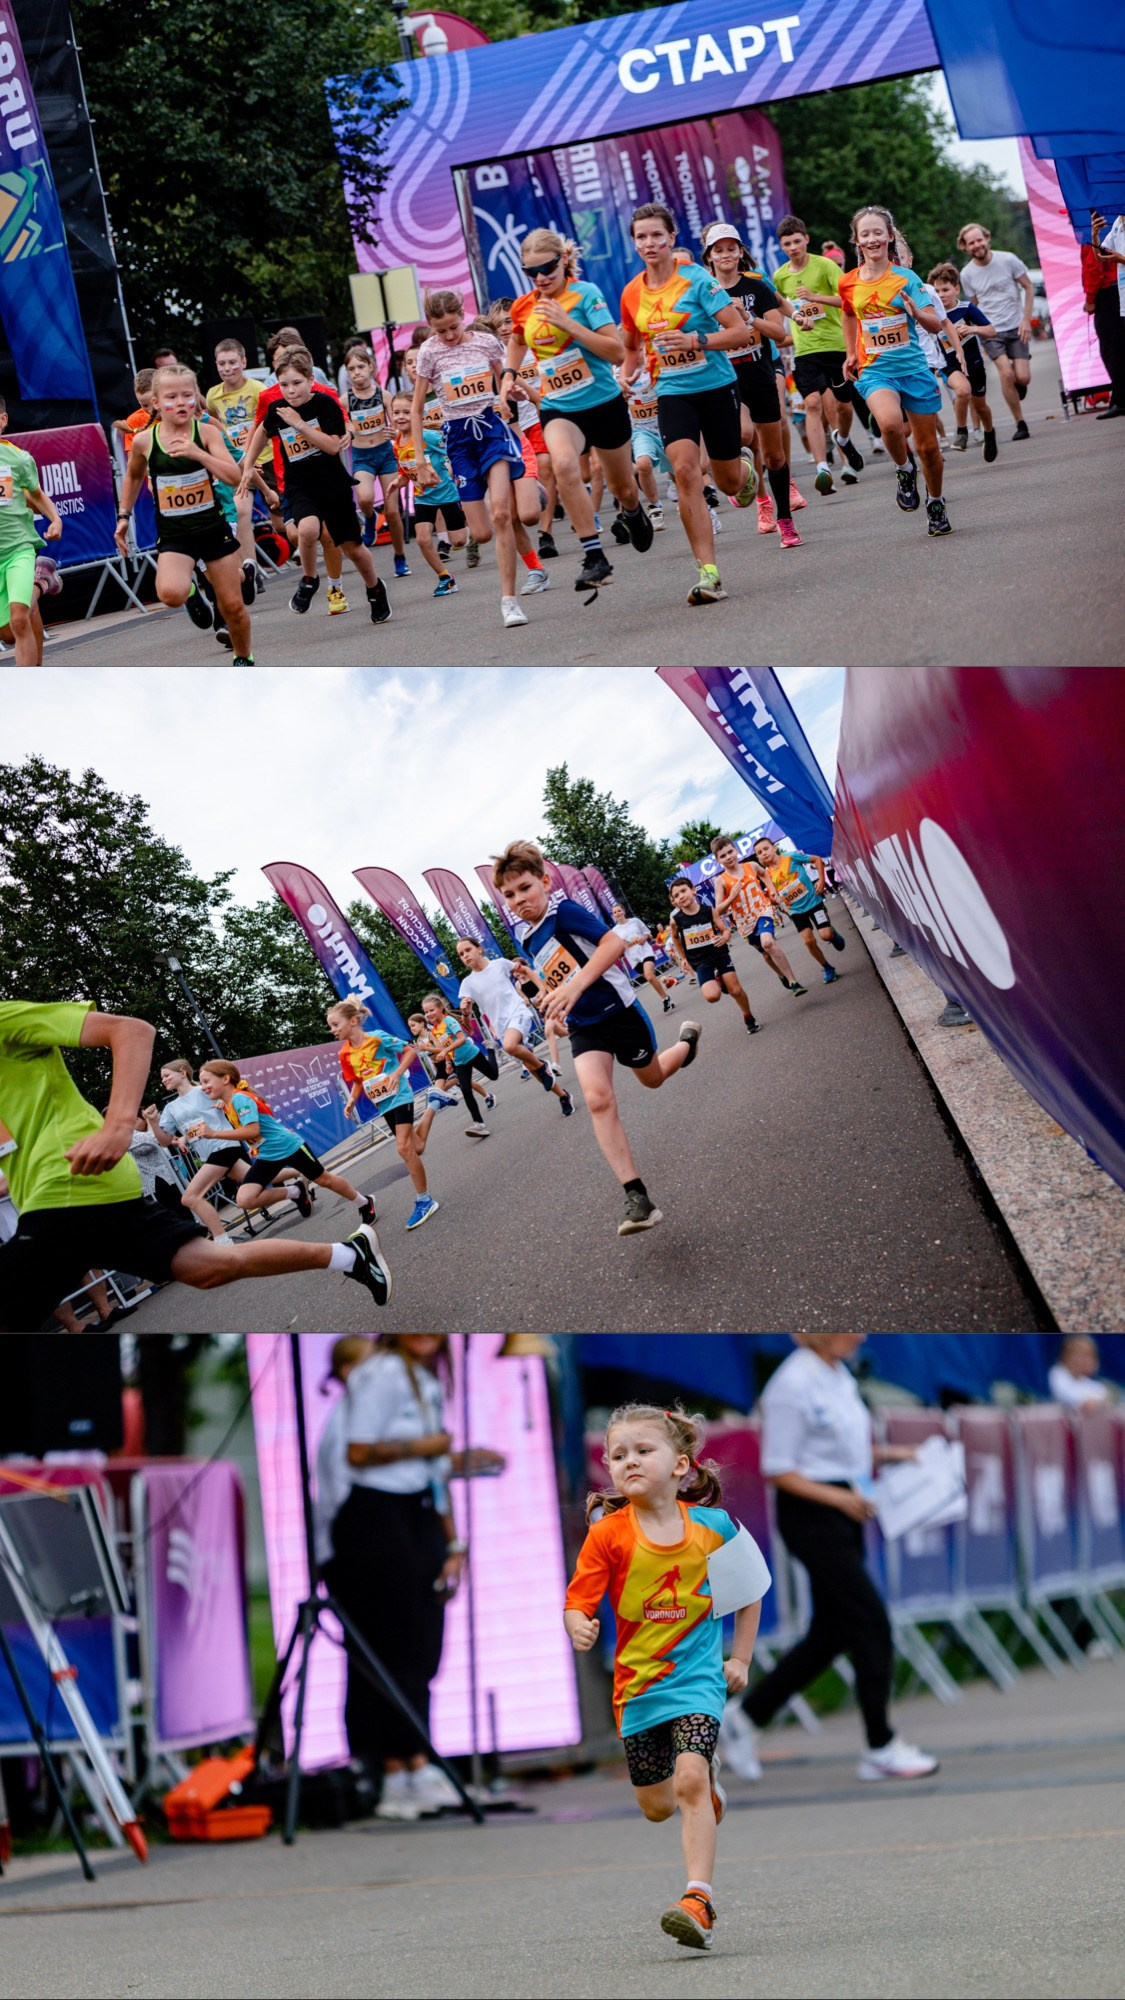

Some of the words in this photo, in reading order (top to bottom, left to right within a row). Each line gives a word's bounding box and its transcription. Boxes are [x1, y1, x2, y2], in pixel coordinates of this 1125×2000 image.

[618, 15, 800, 94] СТАРТ
[799, 306, 819, 318] 069
[871, 332, 902, 346] 1051
[661, 350, 696, 366] 1049
[547, 368, 583, 391] 1050
[454, 381, 486, 398] 1016
[358, 418, 382, 431] 1029
[288, 439, 313, 455] 103
[41, 461, 82, 497] URAL
[166, 490, 204, 508] 1007
[689, 933, 711, 945] 1035
[546, 961, 571, 991] 1038
[645, 1608, 687, 1620] VORONOVO
